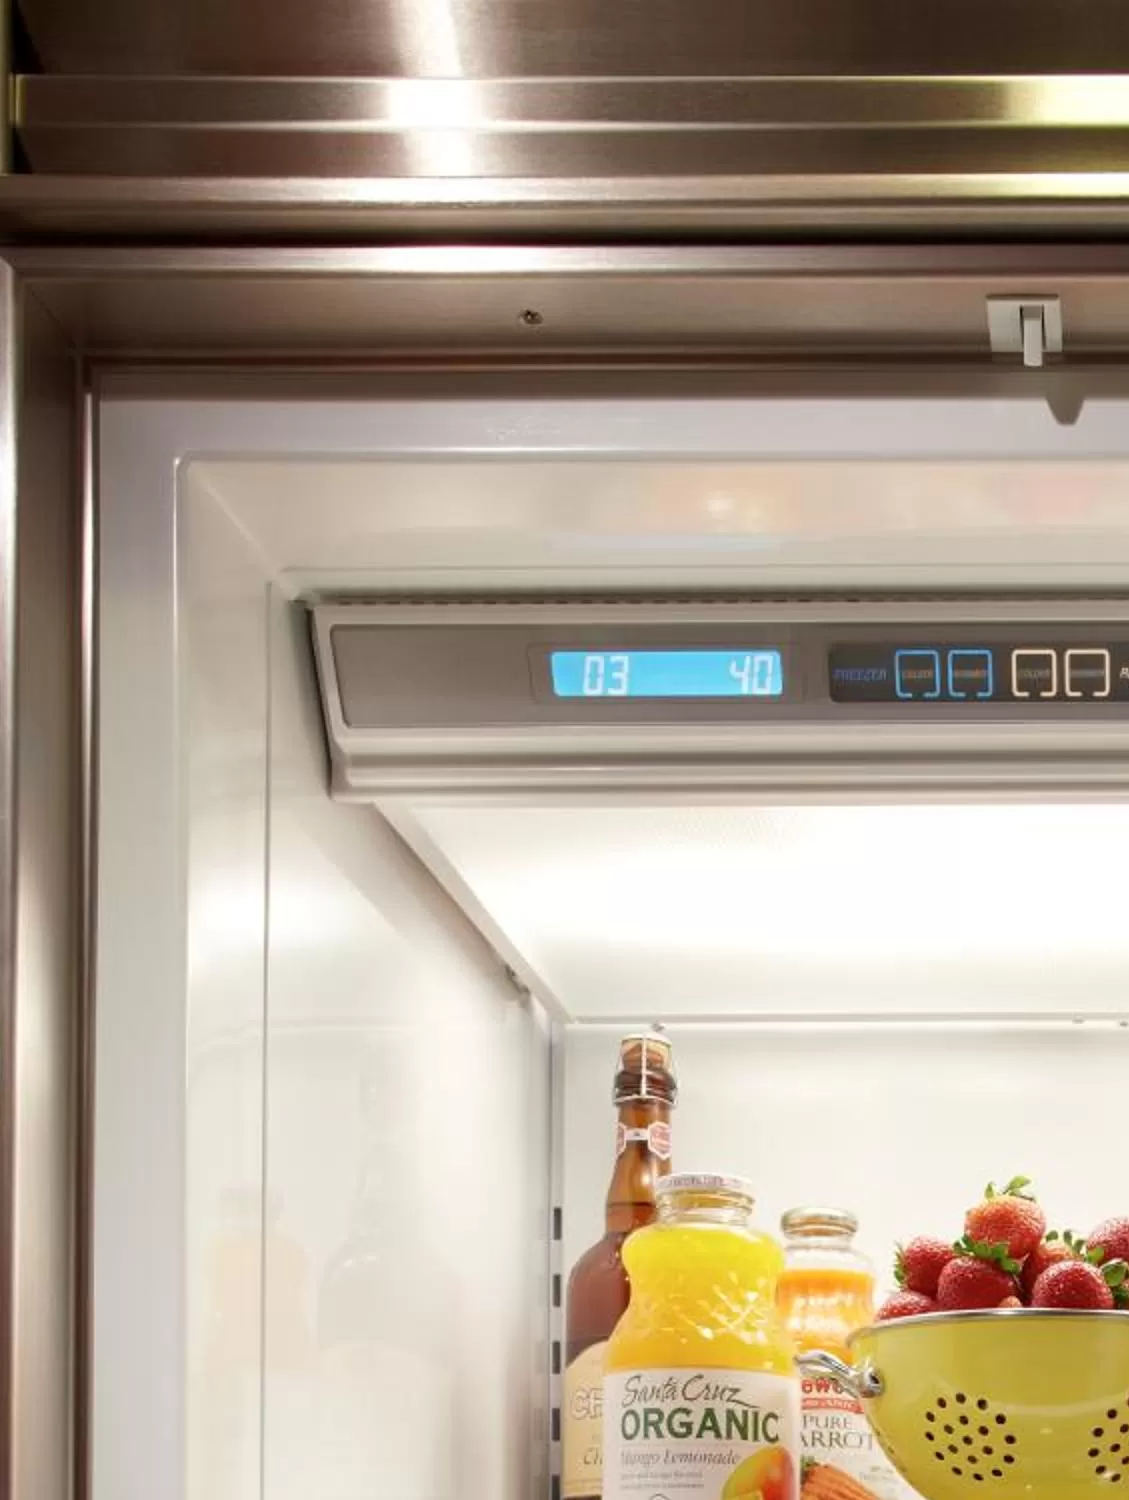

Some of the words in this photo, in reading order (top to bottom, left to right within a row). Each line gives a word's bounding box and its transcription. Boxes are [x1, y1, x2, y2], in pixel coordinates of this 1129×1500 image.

[583, 655, 629, 695] 03
[729, 655, 773, 695] 40
[621, 1374, 678, 1408] Santa
[681, 1374, 760, 1408] Cruz
[620, 1407, 780, 1443] ORGANIC
[803, 1413, 854, 1430] PURE
[663, 1449, 741, 1466] Lemonade
